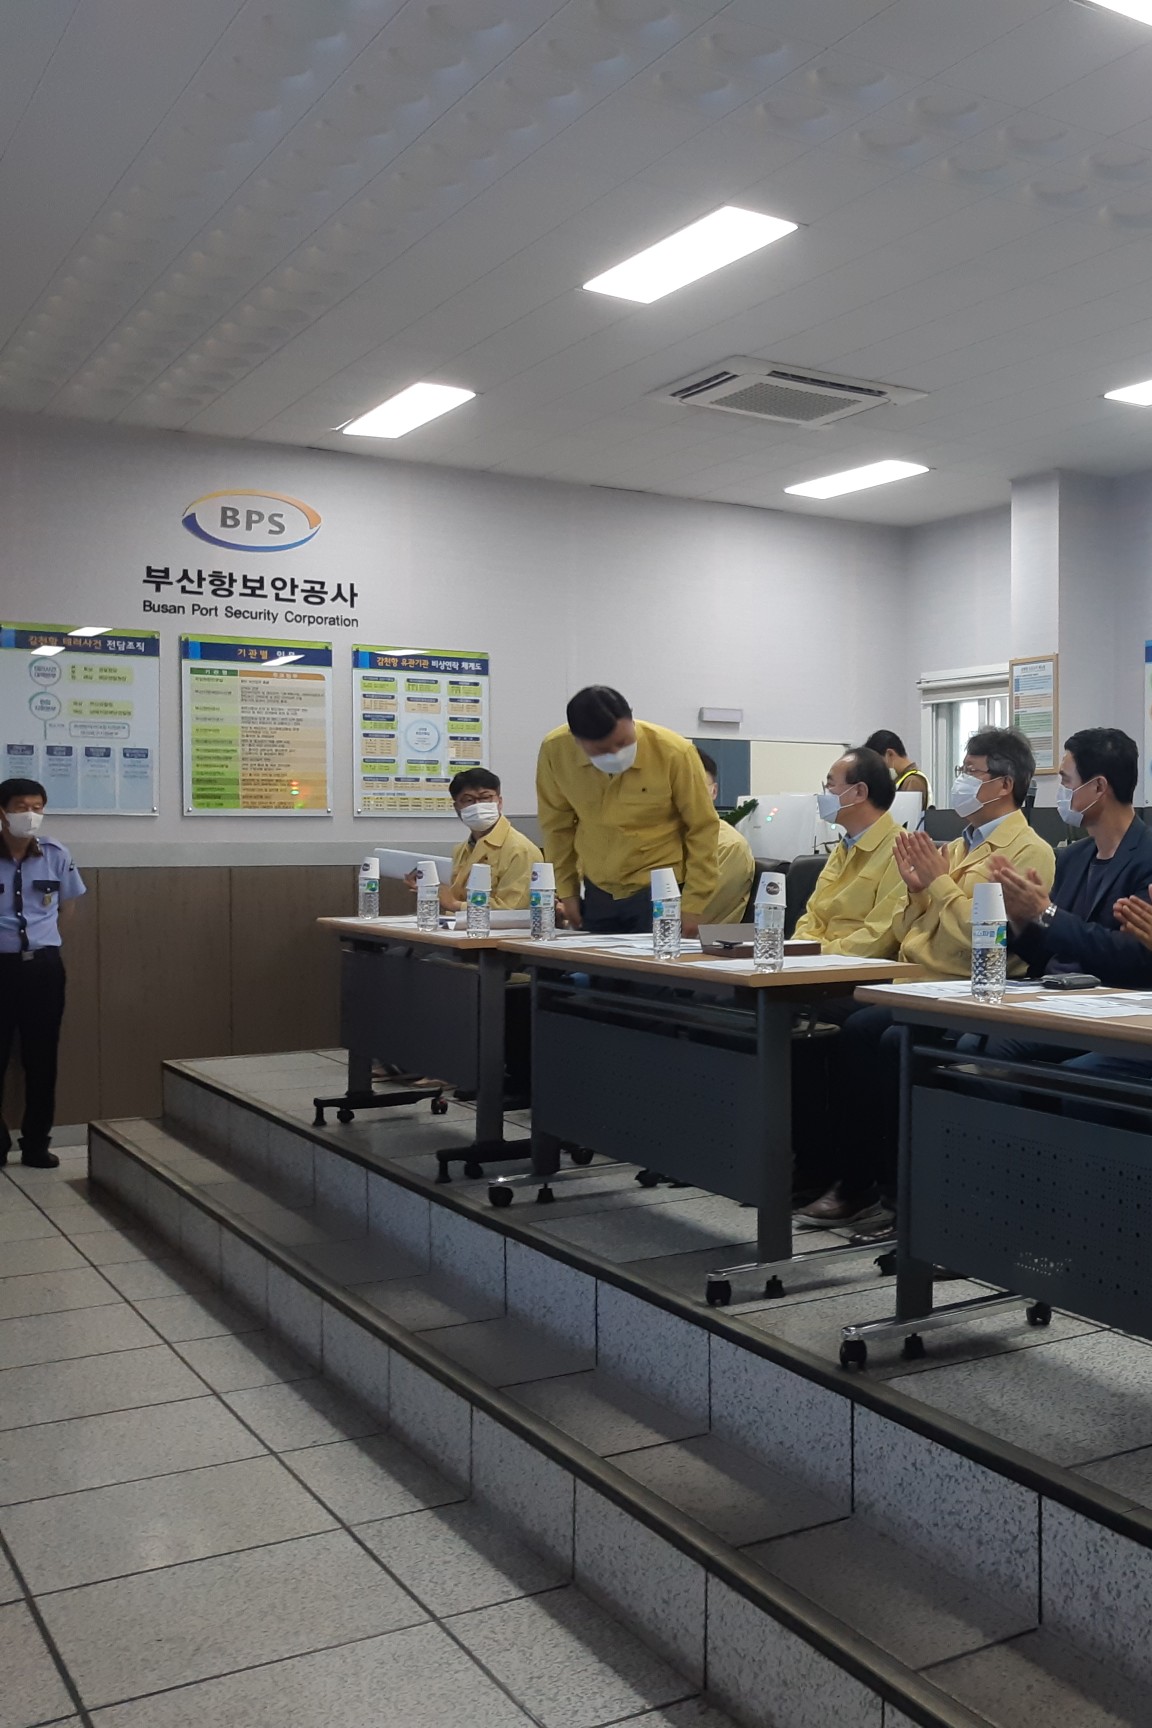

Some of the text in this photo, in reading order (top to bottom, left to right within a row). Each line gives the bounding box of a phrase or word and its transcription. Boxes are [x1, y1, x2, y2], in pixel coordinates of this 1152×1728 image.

[220, 506, 286, 535] BPS
[142, 565, 358, 608] 부산항보안공사
[143, 600, 359, 627] Busan Port Security Corporation
[106, 640, 145, 652] 전담조직
[237, 648, 268, 660] 기관별
[376, 657, 399, 667] 감천항
[401, 658, 429, 669] 유관기관
[431, 660, 459, 671] 비상연락
